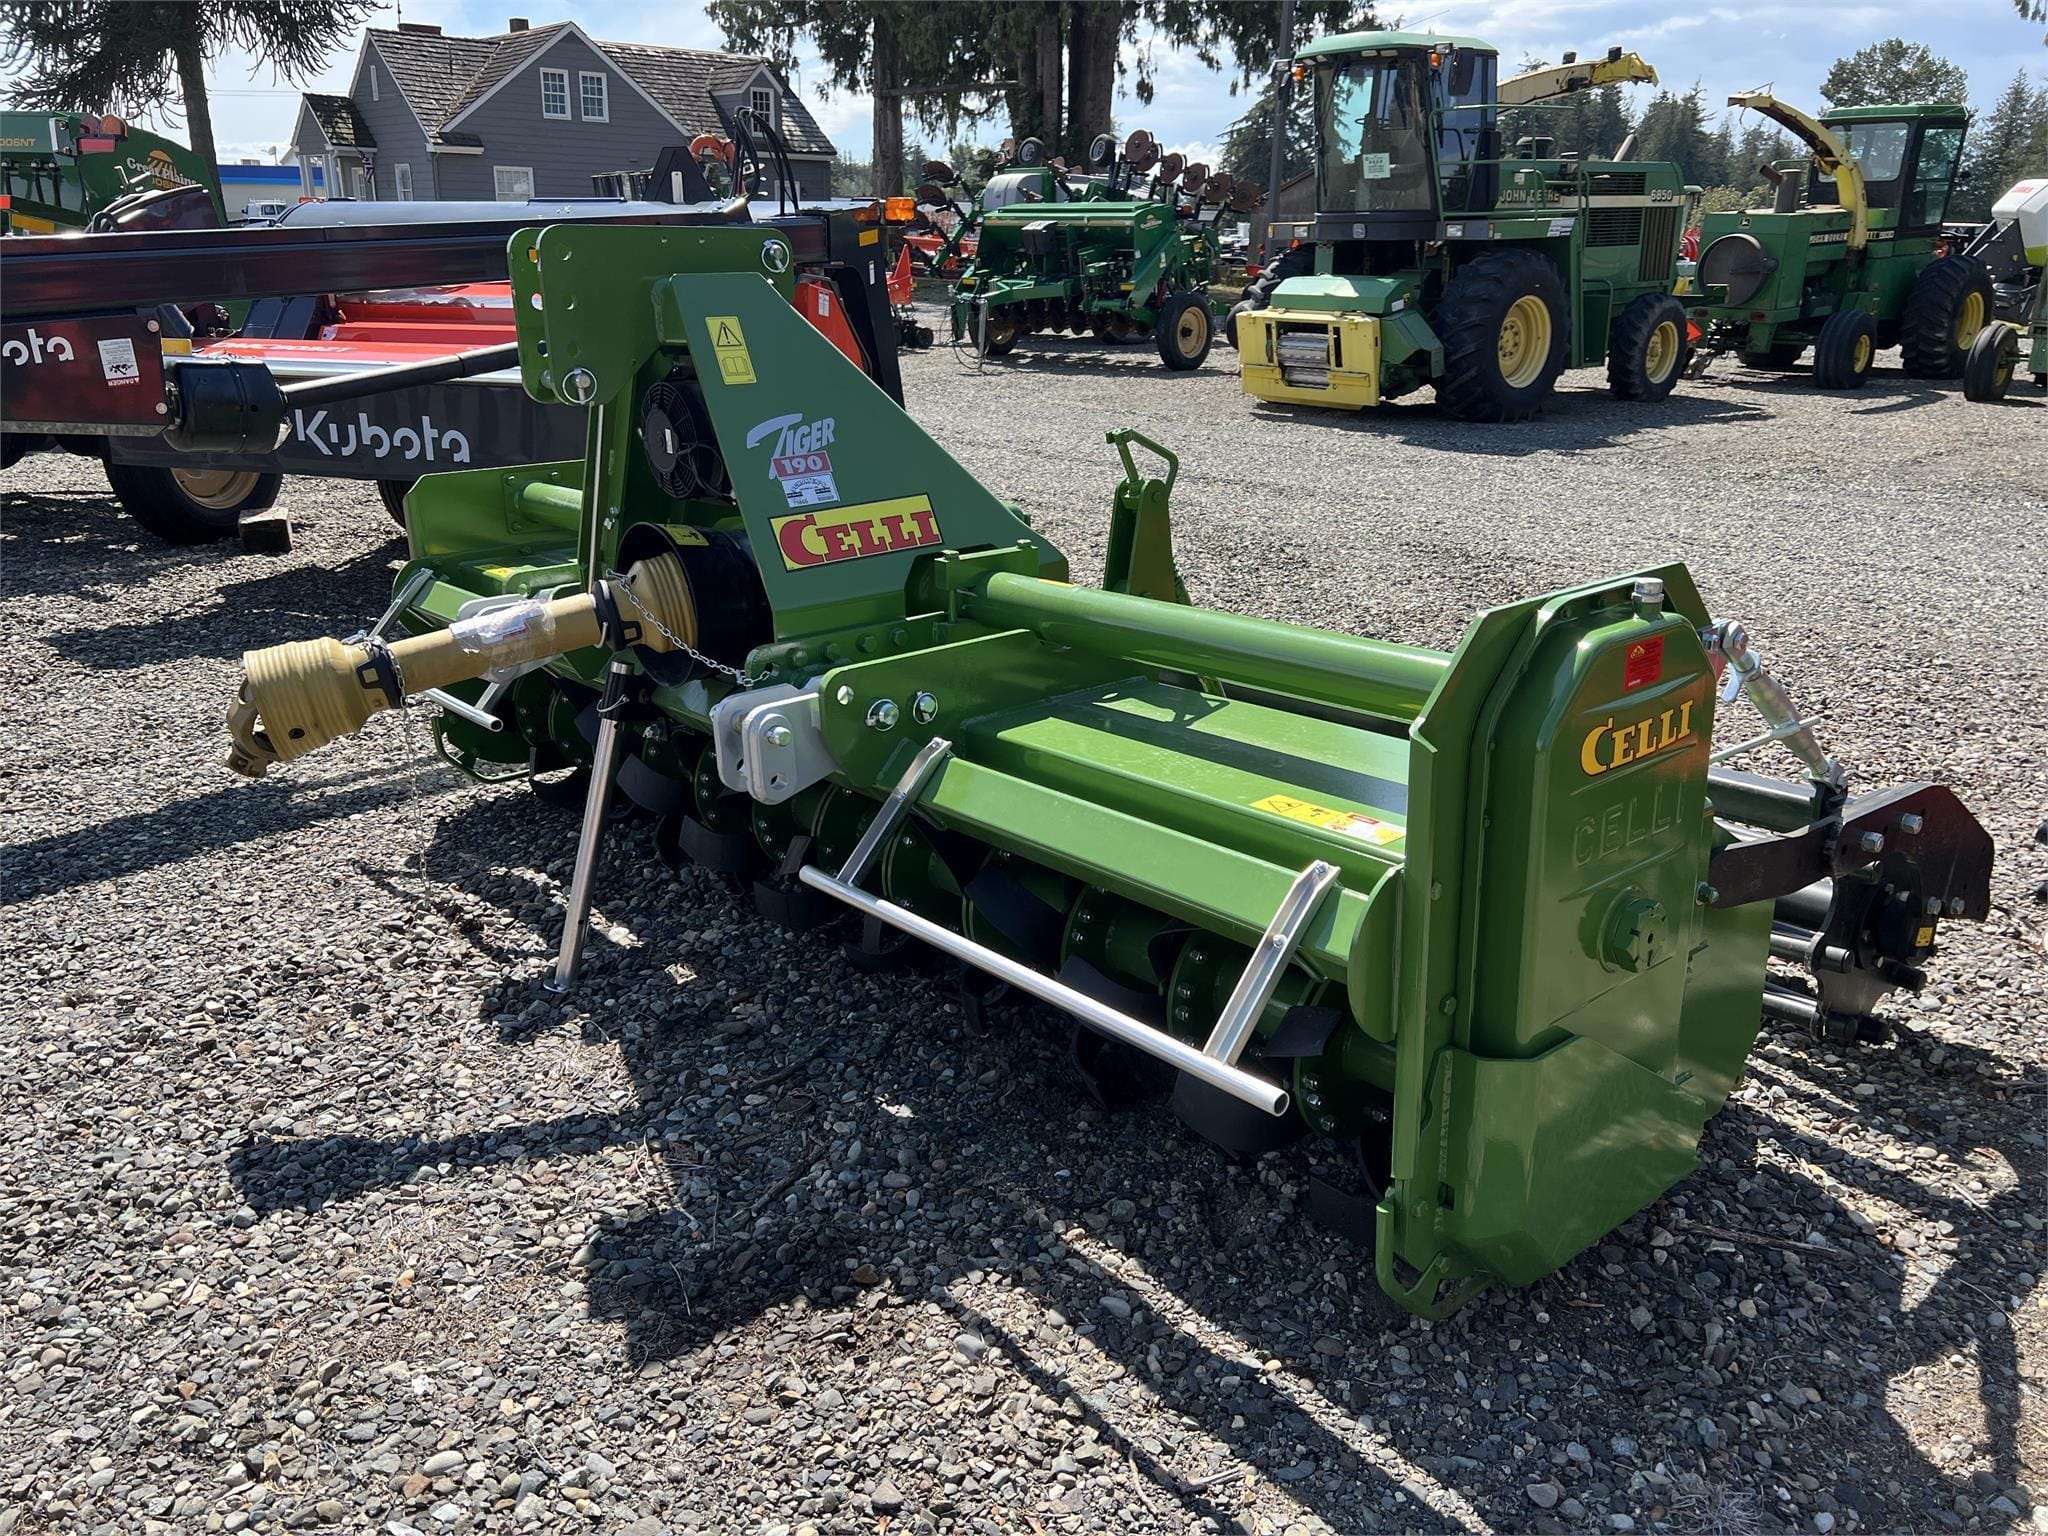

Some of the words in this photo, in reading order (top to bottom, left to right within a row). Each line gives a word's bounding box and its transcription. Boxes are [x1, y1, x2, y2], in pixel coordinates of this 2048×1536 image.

[127, 157, 161, 177] Great
[1500, 189, 1527, 203] JOHN
[1651, 189, 1673, 202] 6850
[2, 328, 75, 366] ota
[294, 408, 471, 463] Kubota
[746, 412, 836, 480] TIGER
[781, 454, 823, 475] 190
[779, 511, 941, 566] CELLI
[1580, 699, 1694, 777] CELLI
[1572, 781, 1684, 868] CELLI
